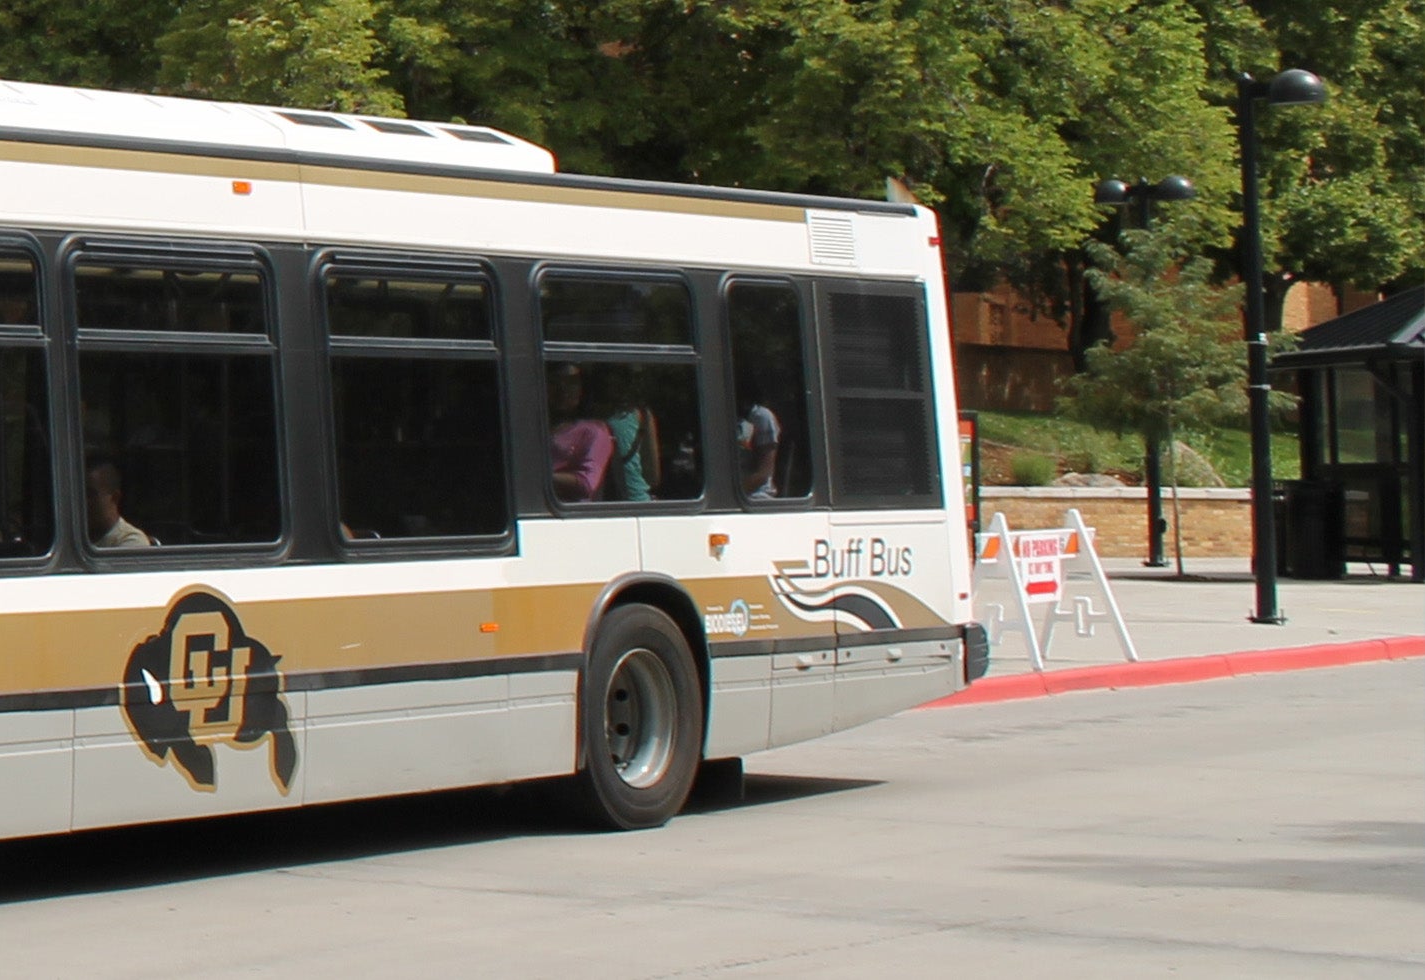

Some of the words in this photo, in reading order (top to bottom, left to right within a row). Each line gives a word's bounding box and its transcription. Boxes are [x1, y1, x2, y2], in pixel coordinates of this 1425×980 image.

[814, 538, 863, 578] Buff
[869, 537, 912, 576] Bus
[169, 611, 252, 745] CU
